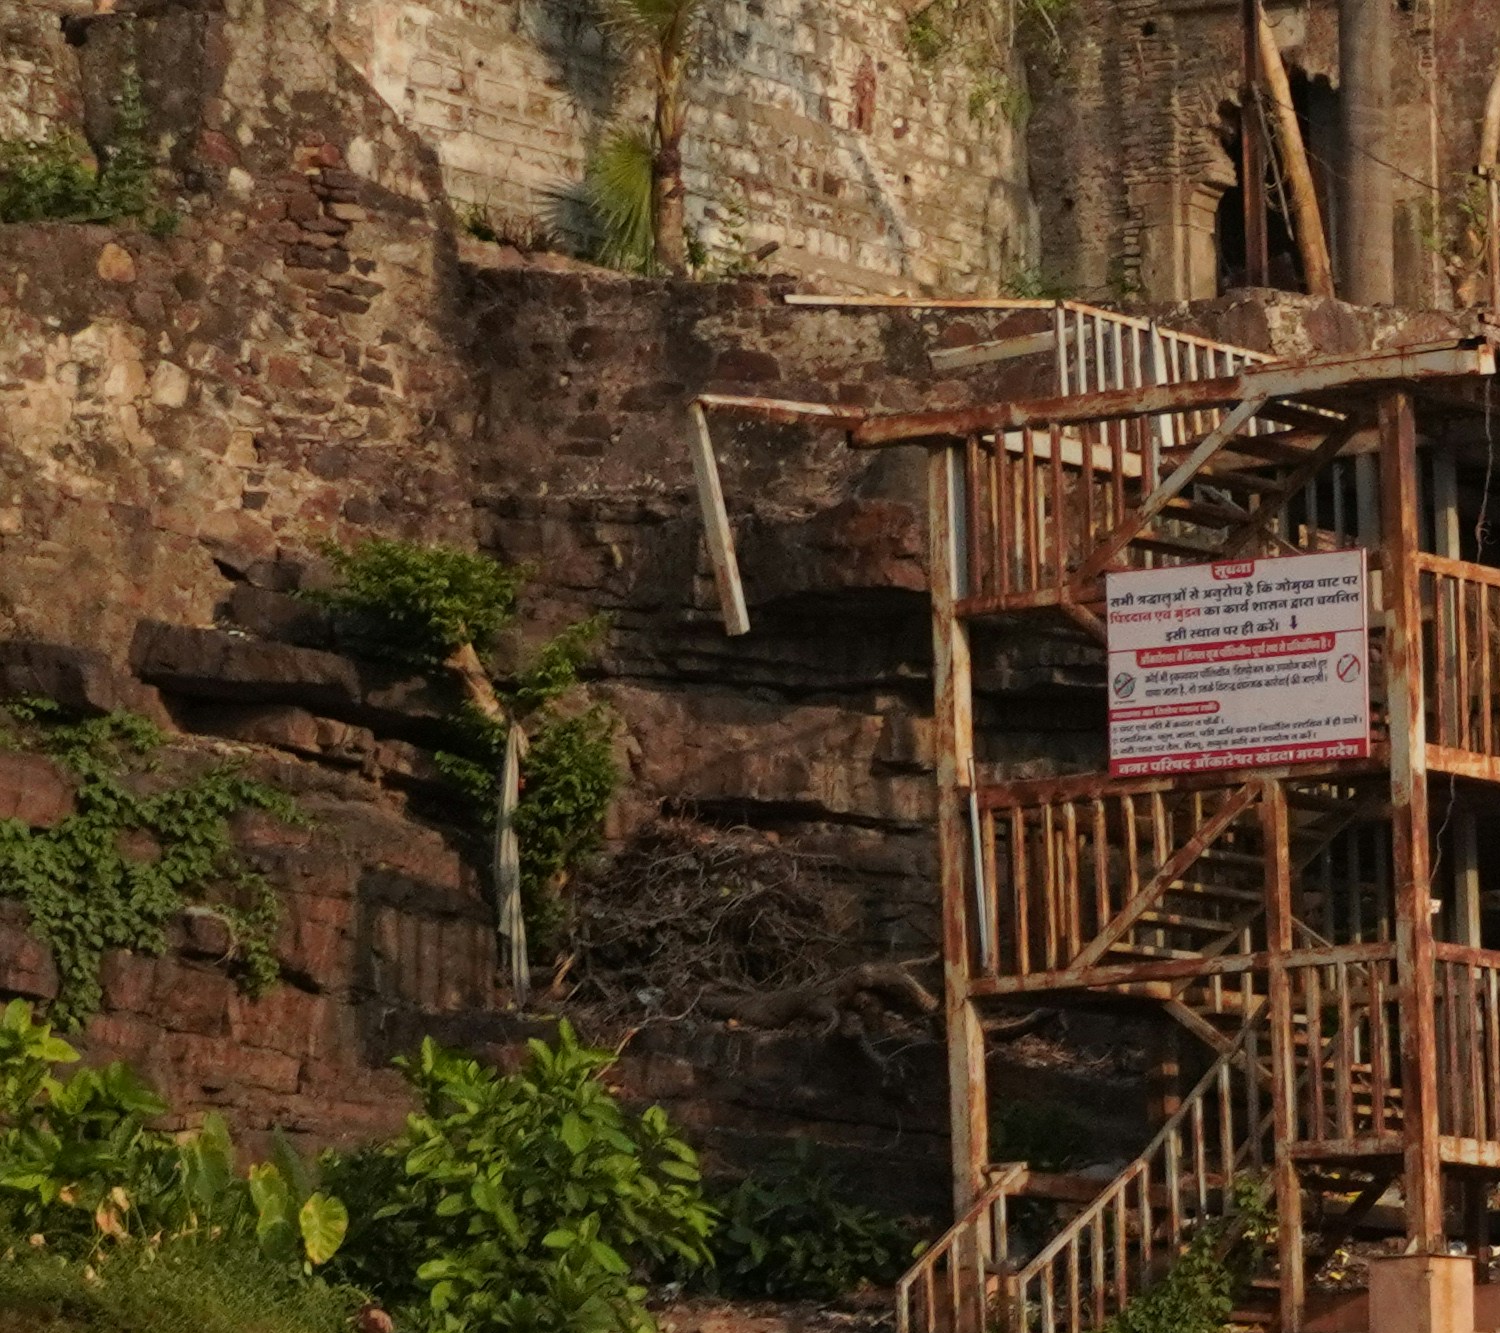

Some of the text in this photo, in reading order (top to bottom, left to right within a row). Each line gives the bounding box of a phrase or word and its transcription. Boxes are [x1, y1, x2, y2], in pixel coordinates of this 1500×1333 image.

[1109, 592, 1134, 608] सभी
[1188, 585, 1200, 600] से
[1244, 581, 1255, 597] है
[1257, 580, 1273, 594] कि
[1317, 576, 1340, 588] घाट
[1341, 575, 1359, 586] पर
[1203, 605, 1220, 617] का
[1252, 600, 1288, 612] शासन
[1290, 597, 1314, 610] द्वारा
[1165, 627, 1187, 643] इसी
[1222, 624, 1239, 637] पर
[1240, 620, 1255, 637] ही
[1119, 761, 1149, 775] नगर
